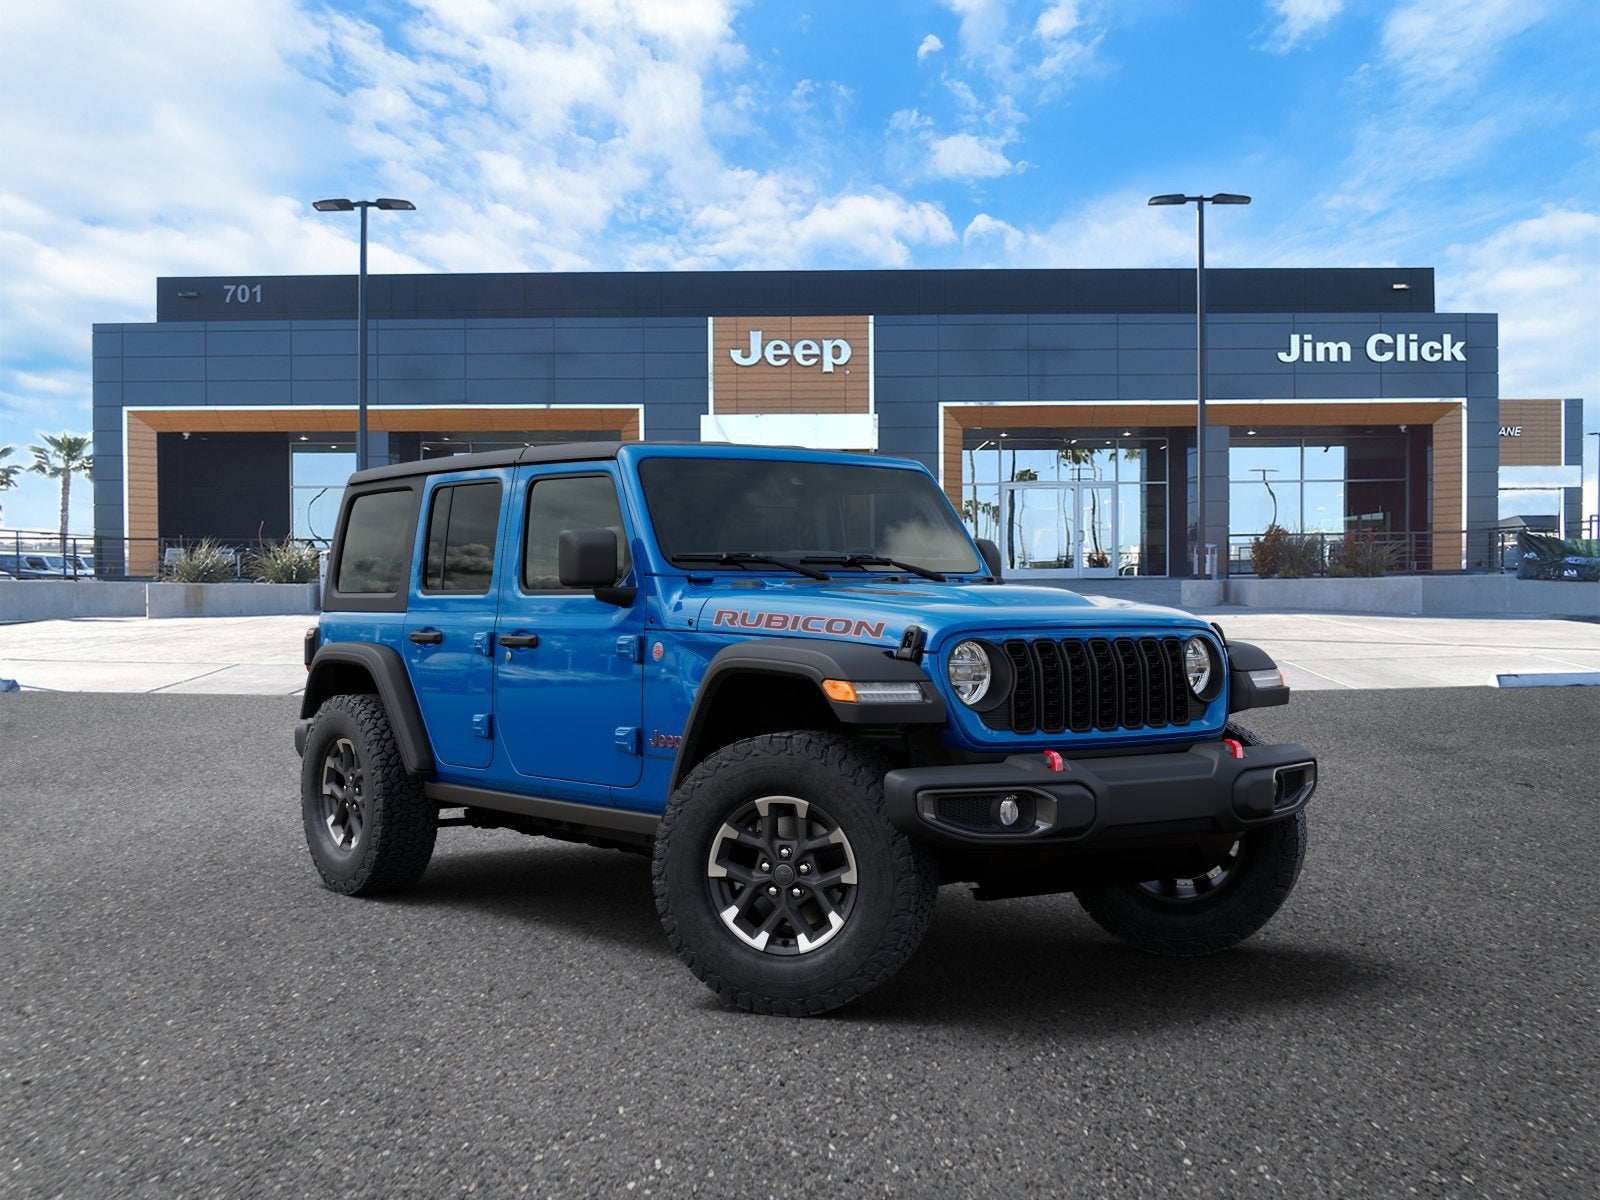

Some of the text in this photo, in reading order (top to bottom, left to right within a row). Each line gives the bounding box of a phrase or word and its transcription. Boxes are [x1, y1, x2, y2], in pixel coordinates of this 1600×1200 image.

[223, 284, 262, 304] 701
[729, 330, 852, 373] Jeep
[1277, 333, 1467, 363] Jim Click
[712, 609, 887, 639] RUBICON
